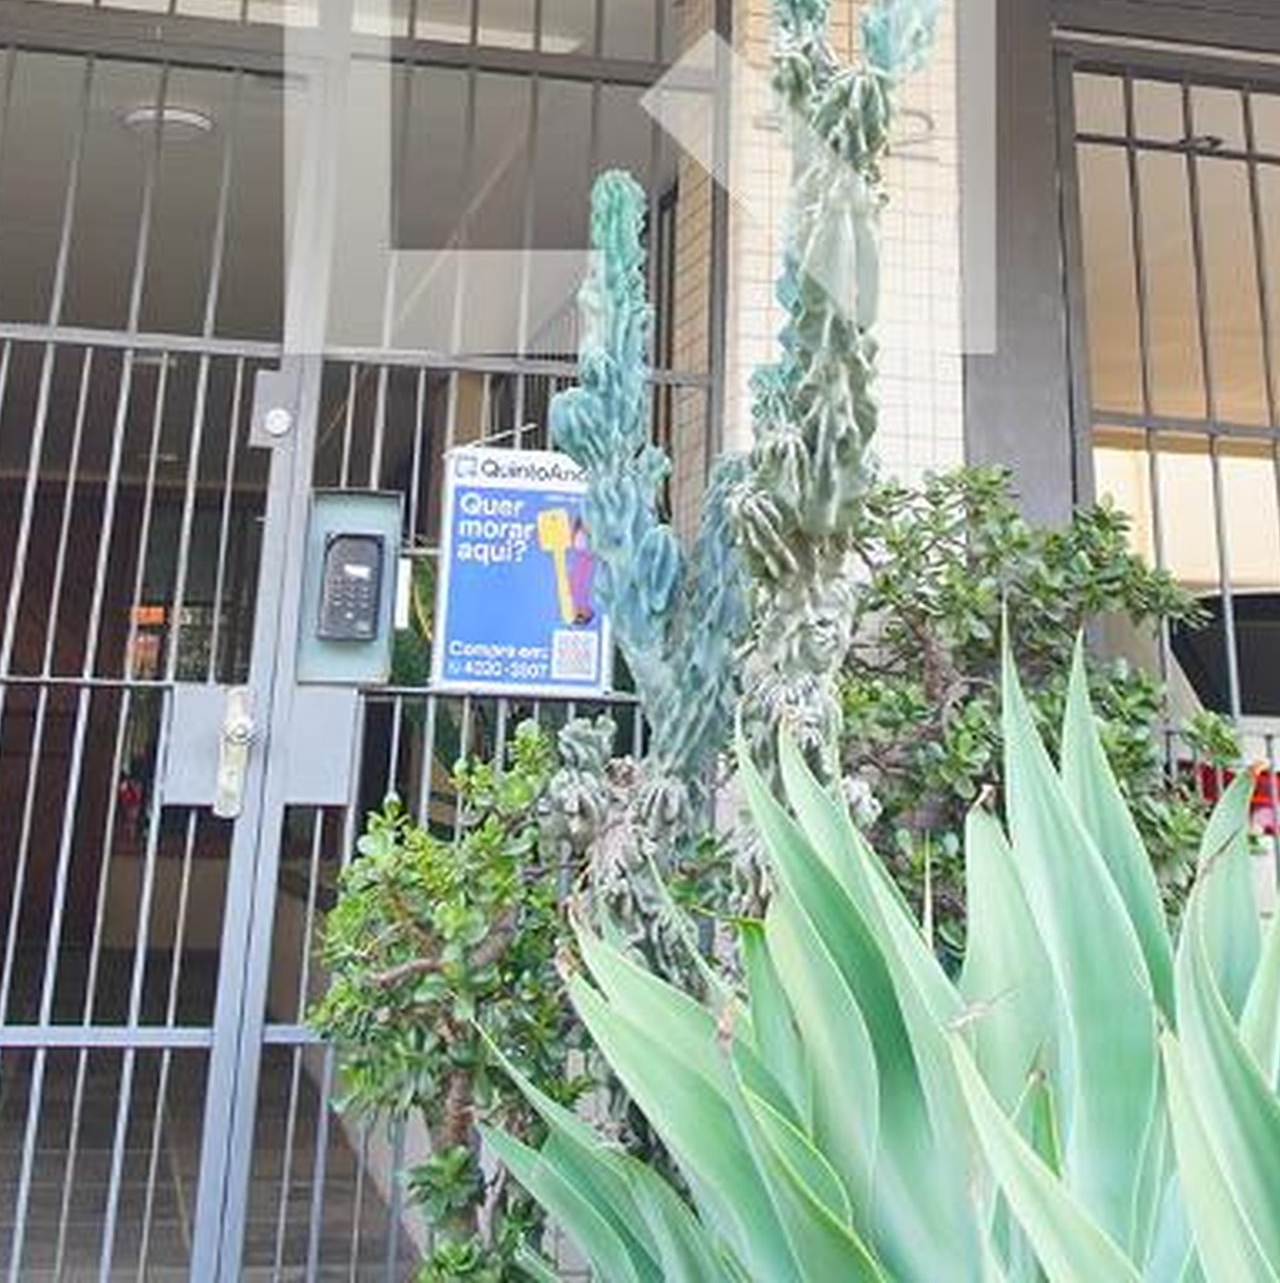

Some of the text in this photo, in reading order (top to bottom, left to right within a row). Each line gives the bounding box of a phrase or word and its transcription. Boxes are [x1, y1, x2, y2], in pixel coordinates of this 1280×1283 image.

[461, 493, 524, 515] Quer
[459, 520, 535, 541] morar
[457, 540, 527, 564] aqui?
